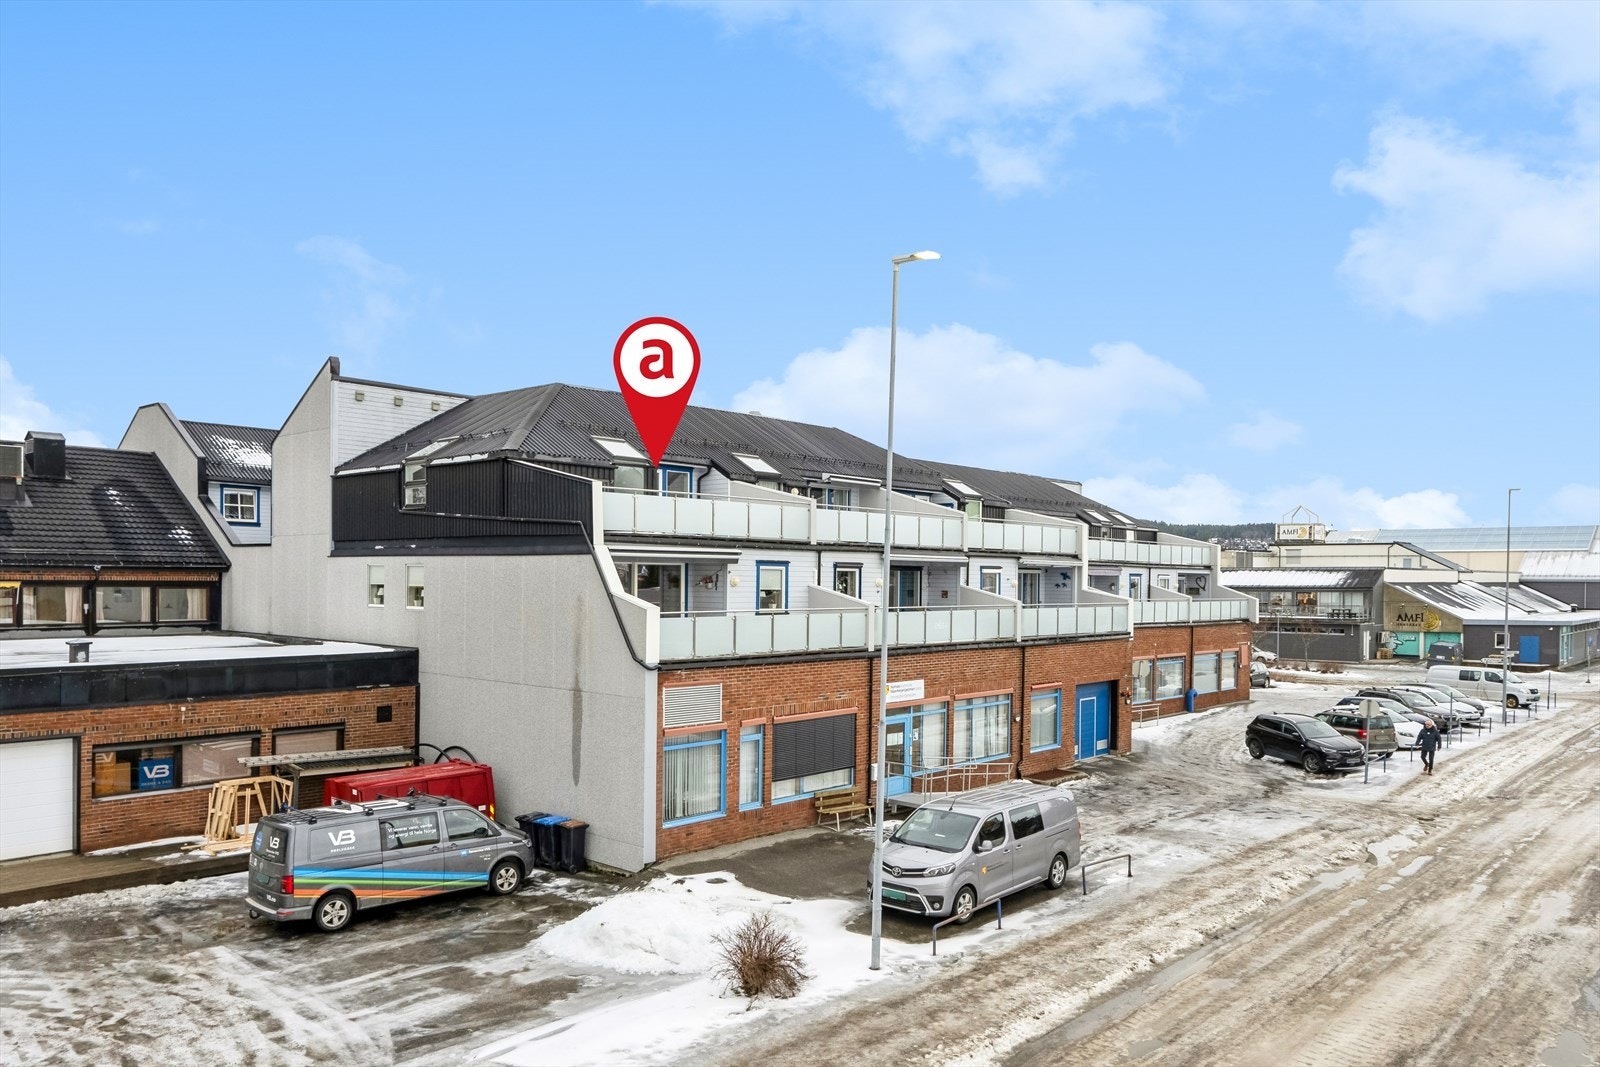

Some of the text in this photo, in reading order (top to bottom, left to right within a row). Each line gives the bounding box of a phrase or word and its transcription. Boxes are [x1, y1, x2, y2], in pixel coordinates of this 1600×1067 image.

[1396, 612, 1424, 622] AMFI
[143, 764, 170, 779] VB
[269, 835, 280, 849] VB
[328, 829, 356, 846] VB
